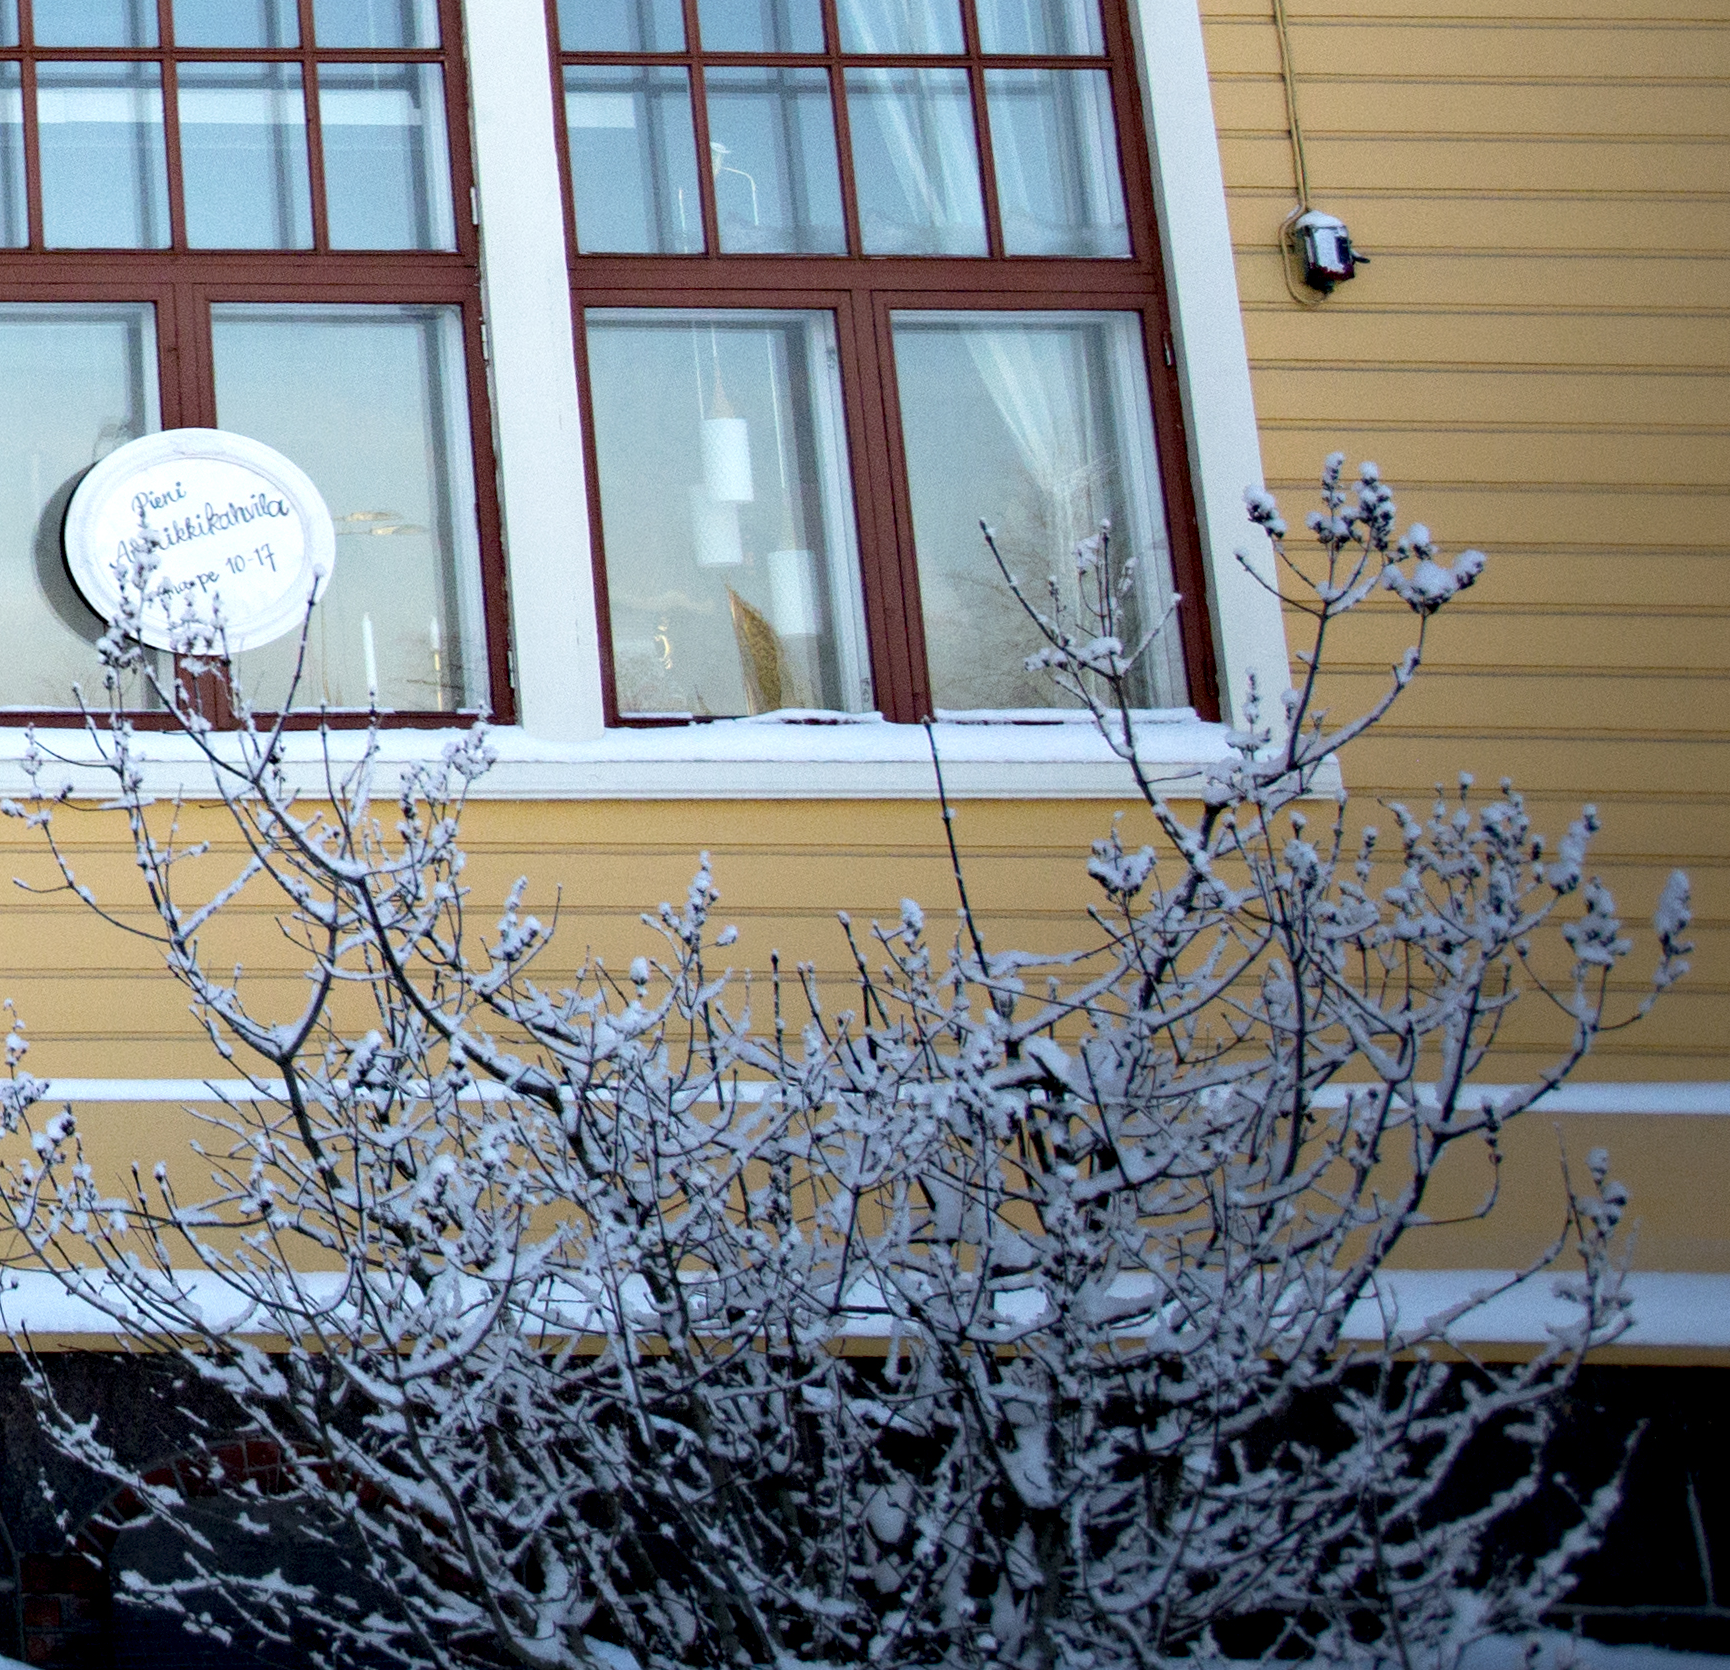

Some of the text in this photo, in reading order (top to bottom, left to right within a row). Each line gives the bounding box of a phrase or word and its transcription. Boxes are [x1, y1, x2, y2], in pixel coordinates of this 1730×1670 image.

[131, 481, 187, 517] Pieni
[109, 492, 290, 569] Aikkikahvila
[225, 543, 277, 573] 10-17
